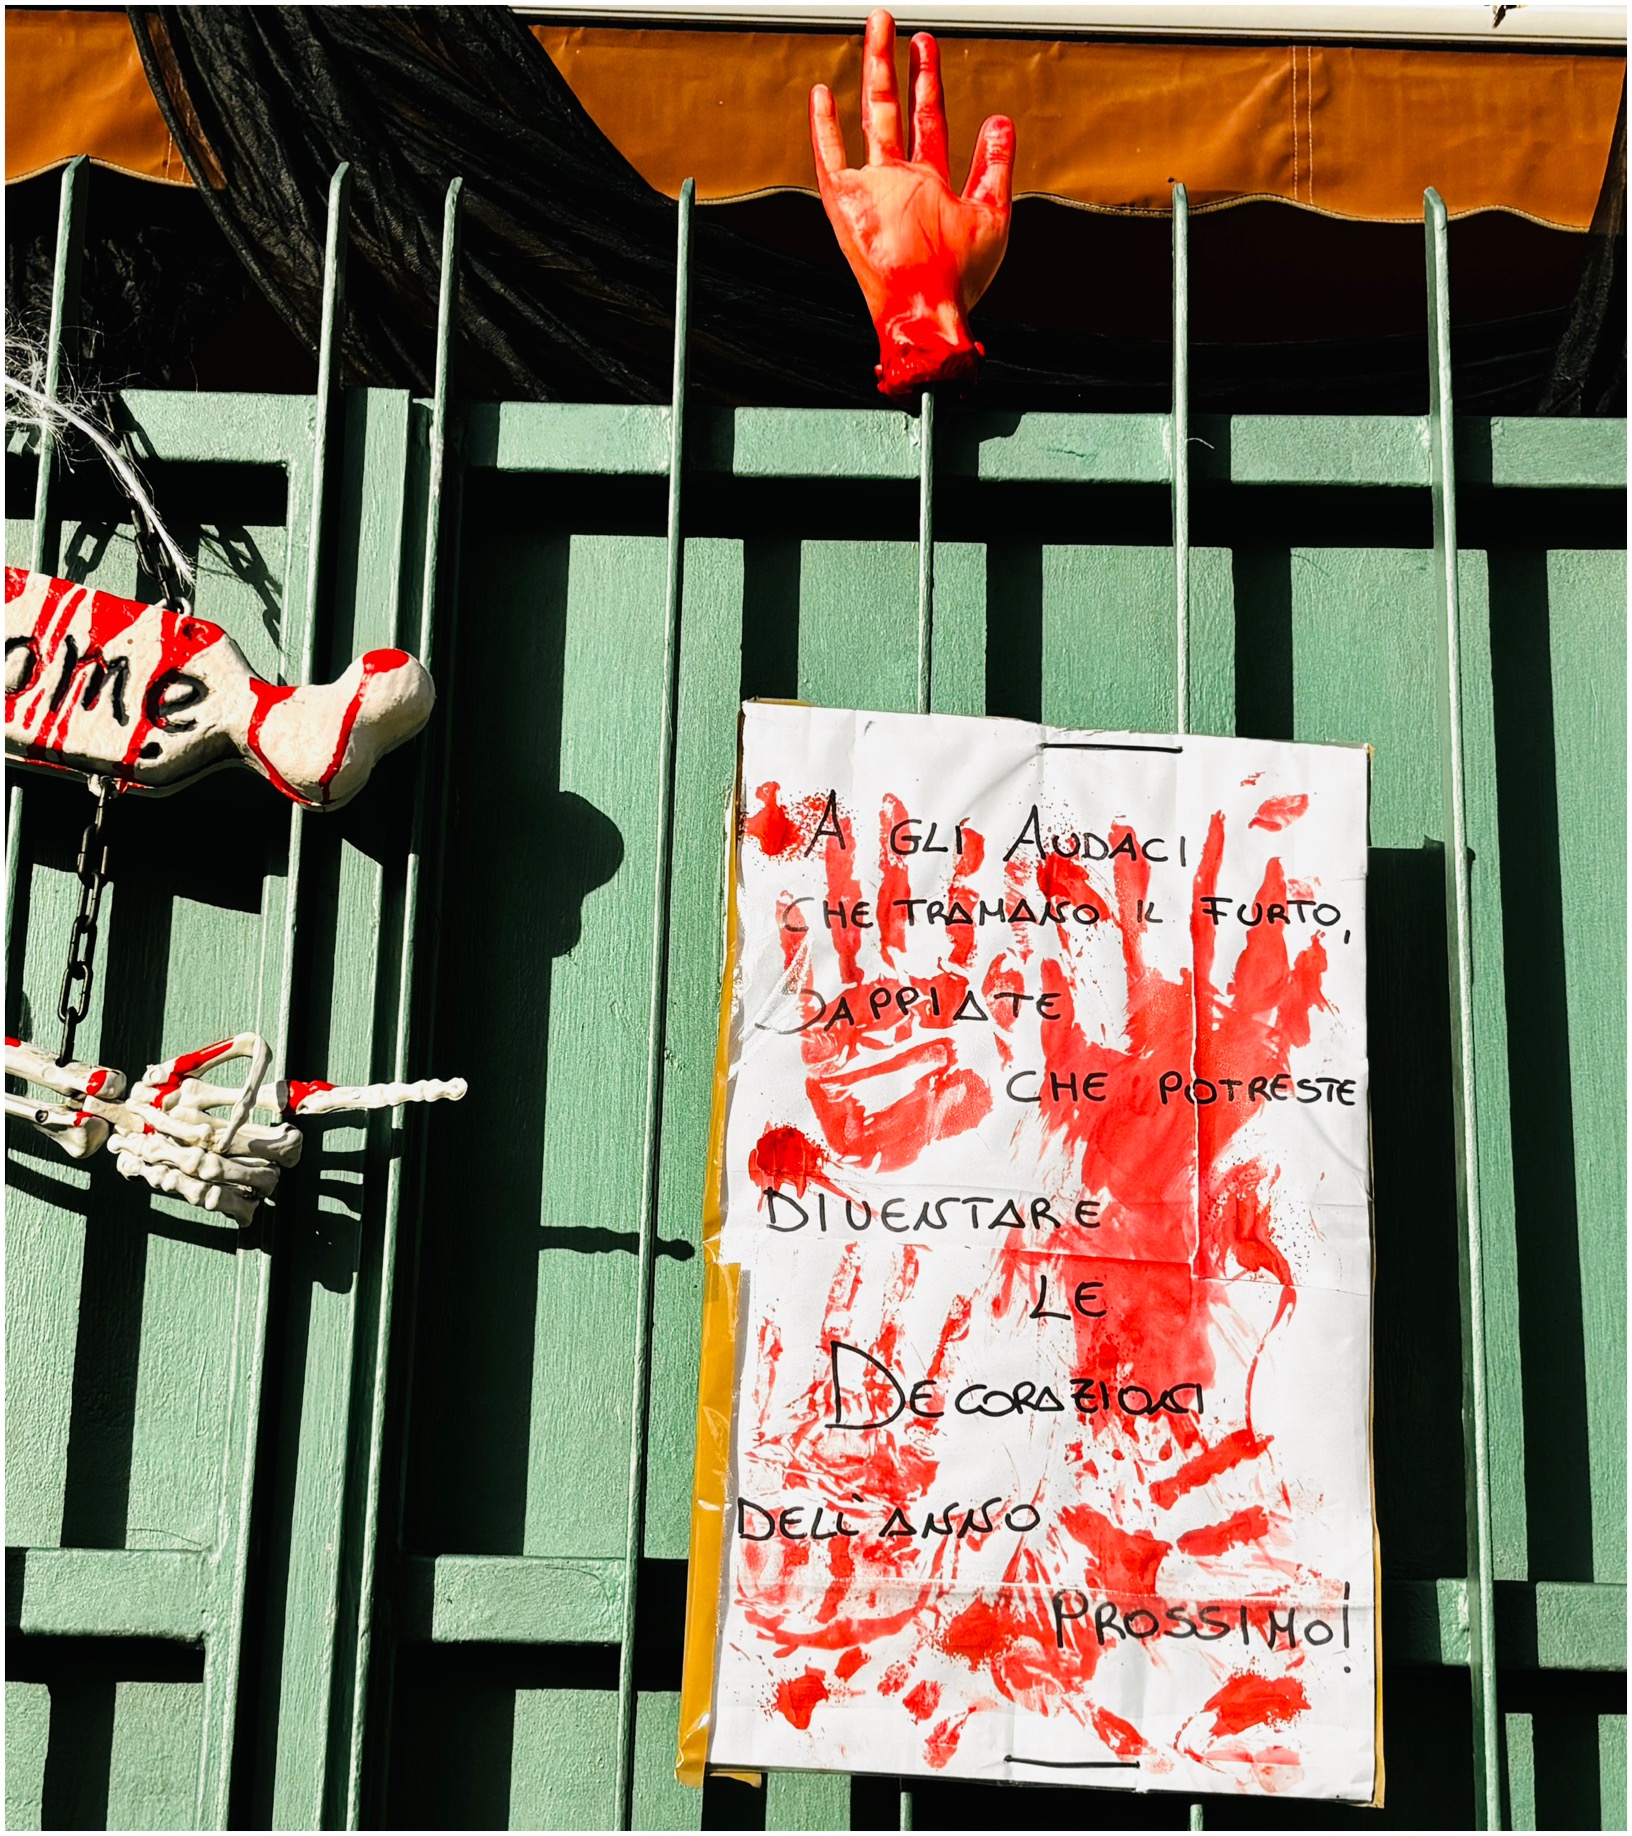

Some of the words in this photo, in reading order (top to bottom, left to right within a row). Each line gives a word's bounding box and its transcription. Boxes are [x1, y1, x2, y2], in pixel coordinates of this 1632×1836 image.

[805, 789, 846, 855] A
[890, 818, 967, 856] GLI
[1002, 805, 1187, 867] AUDACI
[782, 897, 874, 934] CHE
[893, 899, 1101, 927] TRAMANO
[1136, 899, 1163, 924] IL
[1202, 896, 1352, 945] FURTO,
[1006, 1070, 1108, 1104] CHE
[1158, 1069, 1357, 1107] POTRESTE
[1029, 1275, 1108, 1321] LE
[1053, 1581, 1352, 1674] PROSSIMO!
